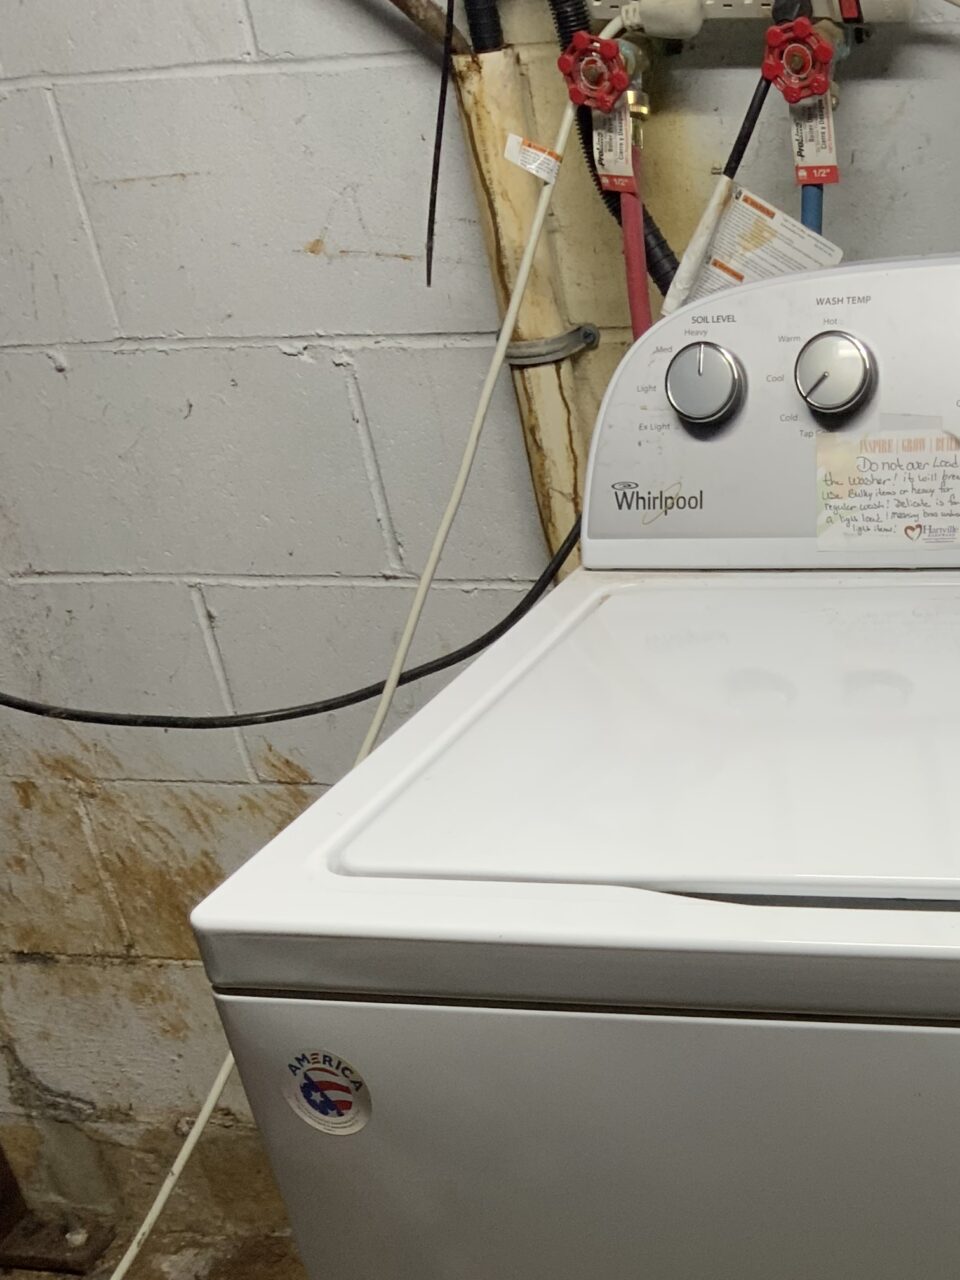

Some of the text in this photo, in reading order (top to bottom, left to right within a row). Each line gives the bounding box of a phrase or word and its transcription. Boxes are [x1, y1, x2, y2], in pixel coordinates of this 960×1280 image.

[813, 168, 831, 177] 1/2"
[816, 296, 871, 305] WASH TEMP
[691, 315, 736, 324] SOIL LEVEL
[684, 329, 708, 337] Heavy
[637, 385, 656, 393] Light
[650, 423, 670, 432] Light
[800, 430, 813, 439] Tap
[856, 455, 879, 473] Do
[881, 458, 904, 471] not
[905, 461, 929, 471] over
[917, 473, 937, 482] will
[614, 489, 703, 516] Whirlpool
[288, 1053, 363, 1092] AMERICA
